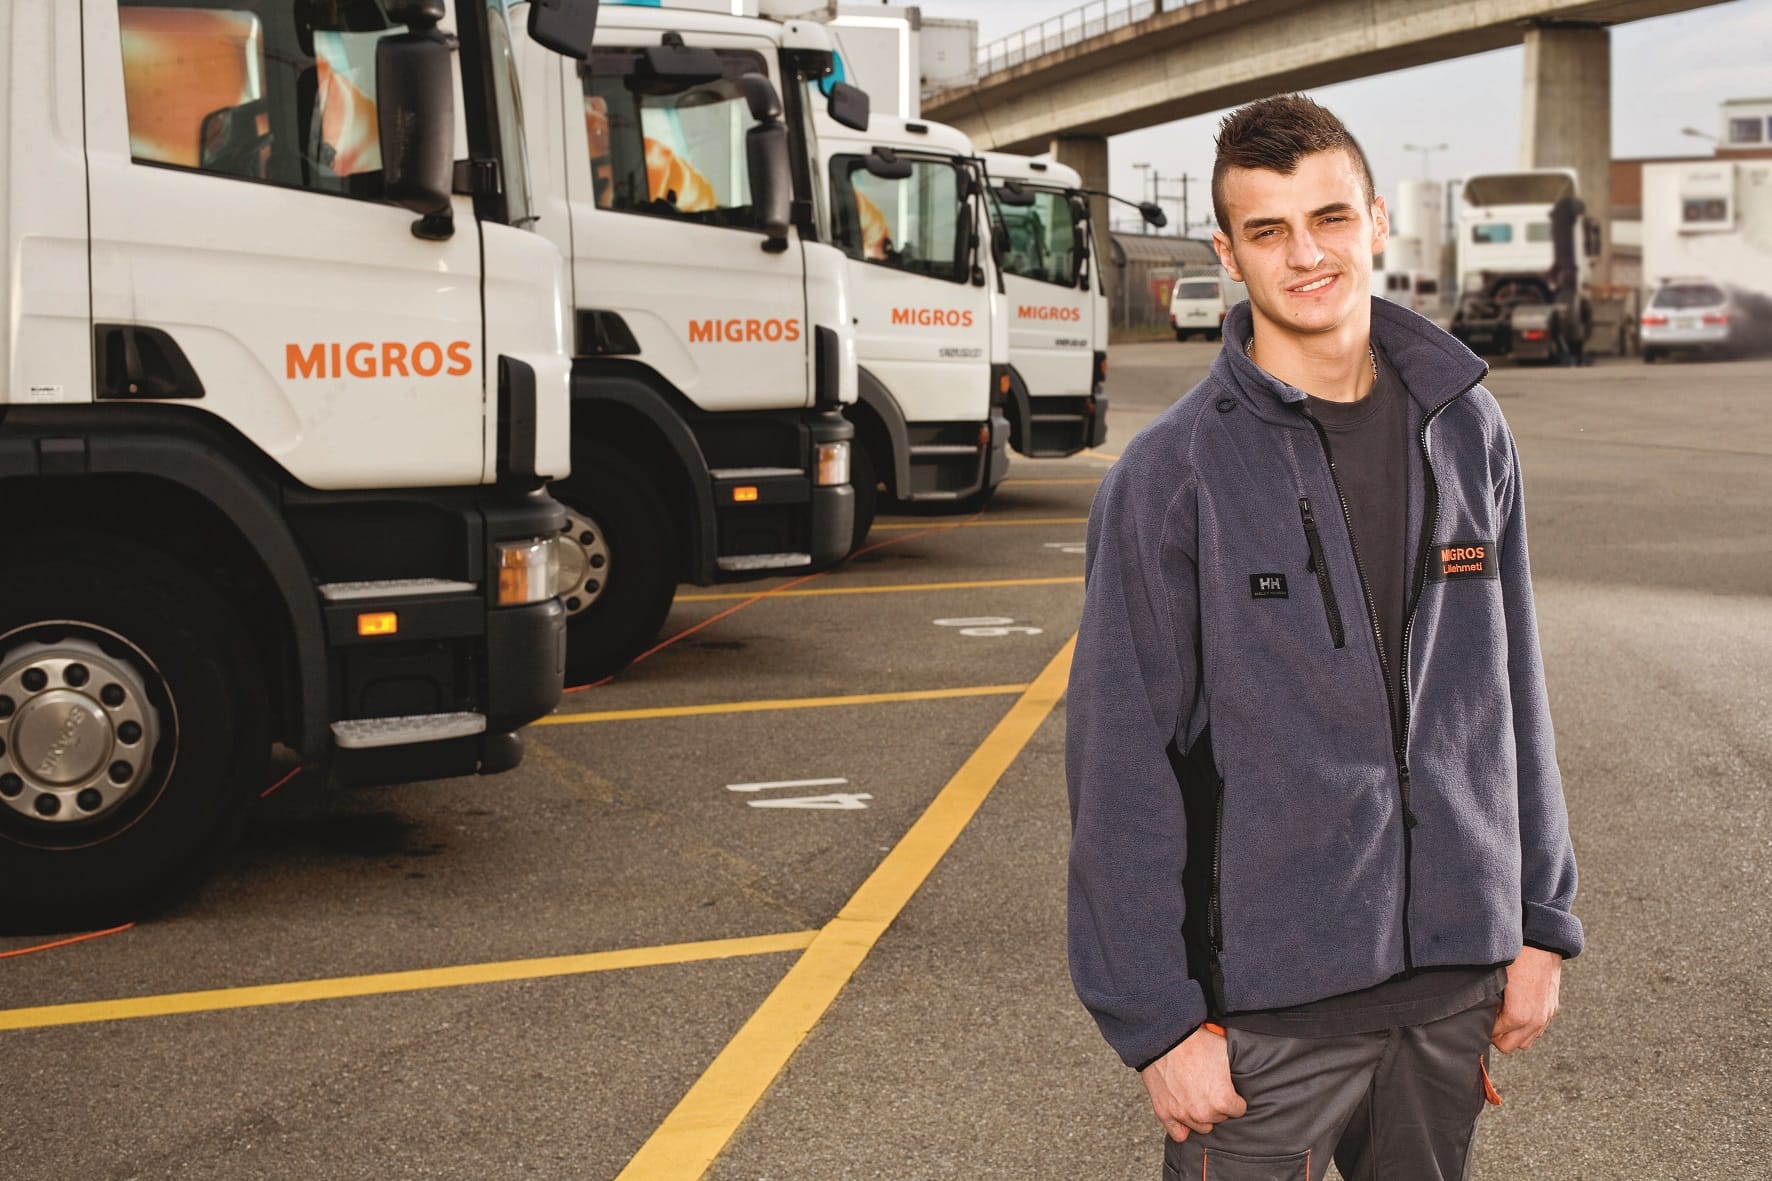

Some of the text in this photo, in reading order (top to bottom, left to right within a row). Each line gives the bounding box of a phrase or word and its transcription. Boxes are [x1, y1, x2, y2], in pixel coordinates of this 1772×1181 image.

[891, 308, 974, 328] MIGROS
[1018, 305, 1080, 323] MIGROS
[688, 317, 801, 344] MIGROS
[285, 340, 473, 380] MIGROS
[1259, 577, 1281, 590] HH
